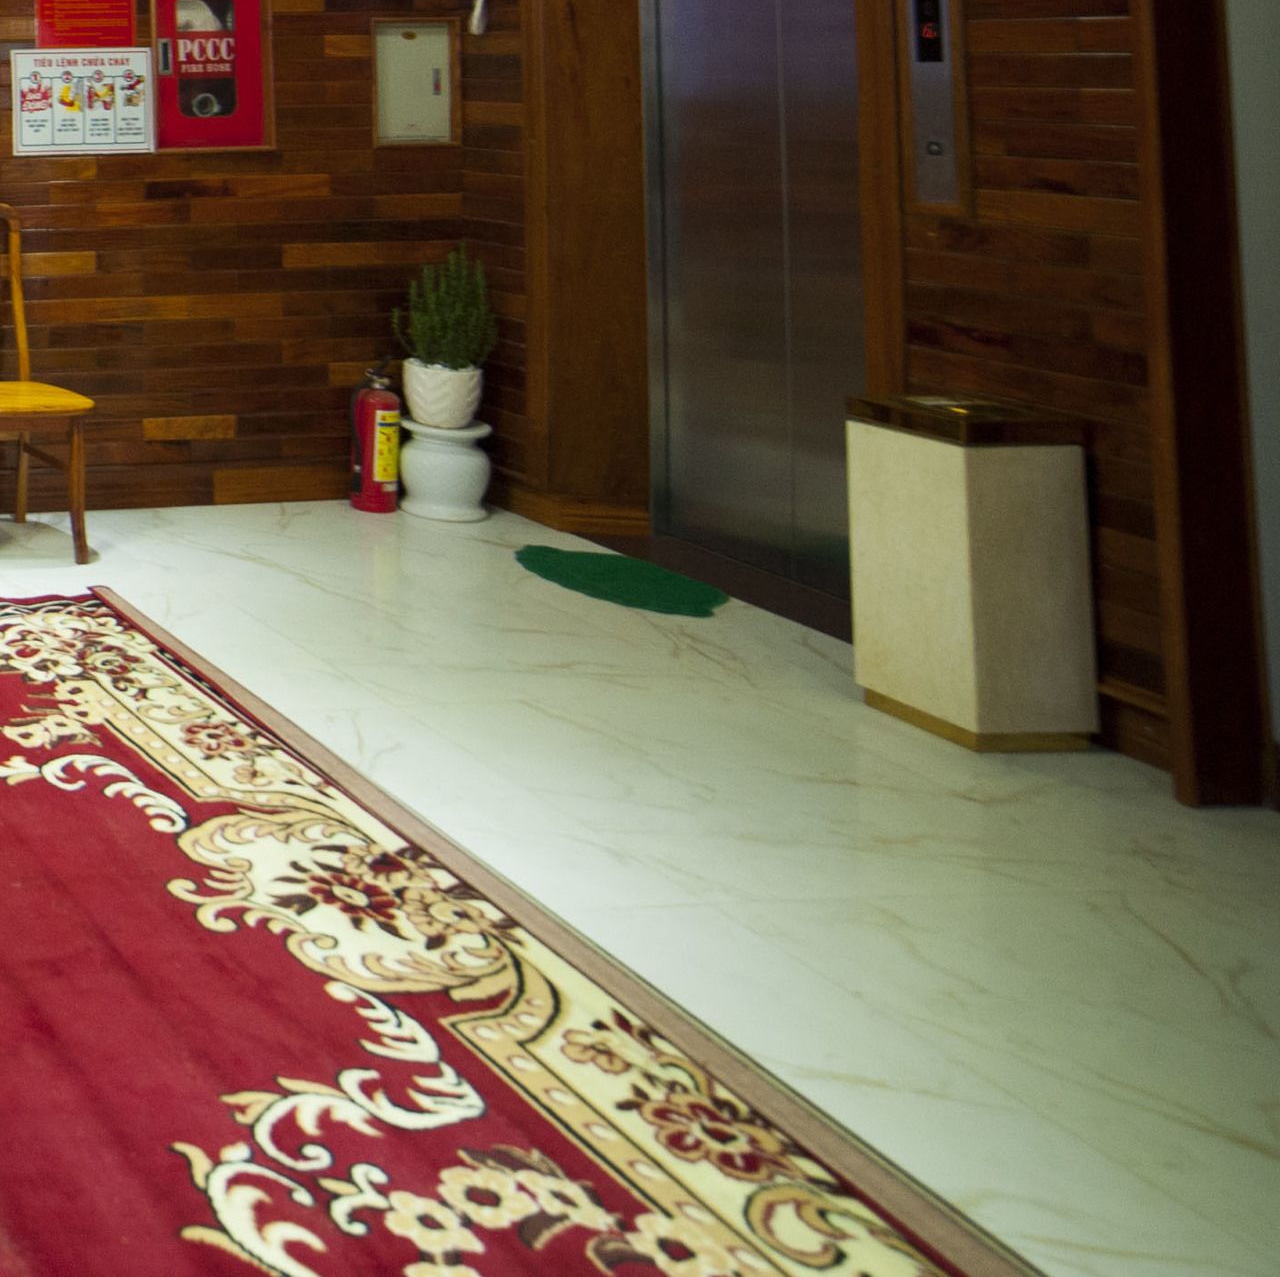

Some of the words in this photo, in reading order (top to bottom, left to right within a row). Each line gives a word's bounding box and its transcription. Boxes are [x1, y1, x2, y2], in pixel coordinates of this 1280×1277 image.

[176, 38, 236, 62] PCCC
[55, 57, 79, 67] LỆNH
[181, 64, 205, 73] FIRE
[206, 63, 232, 72] HOSE
